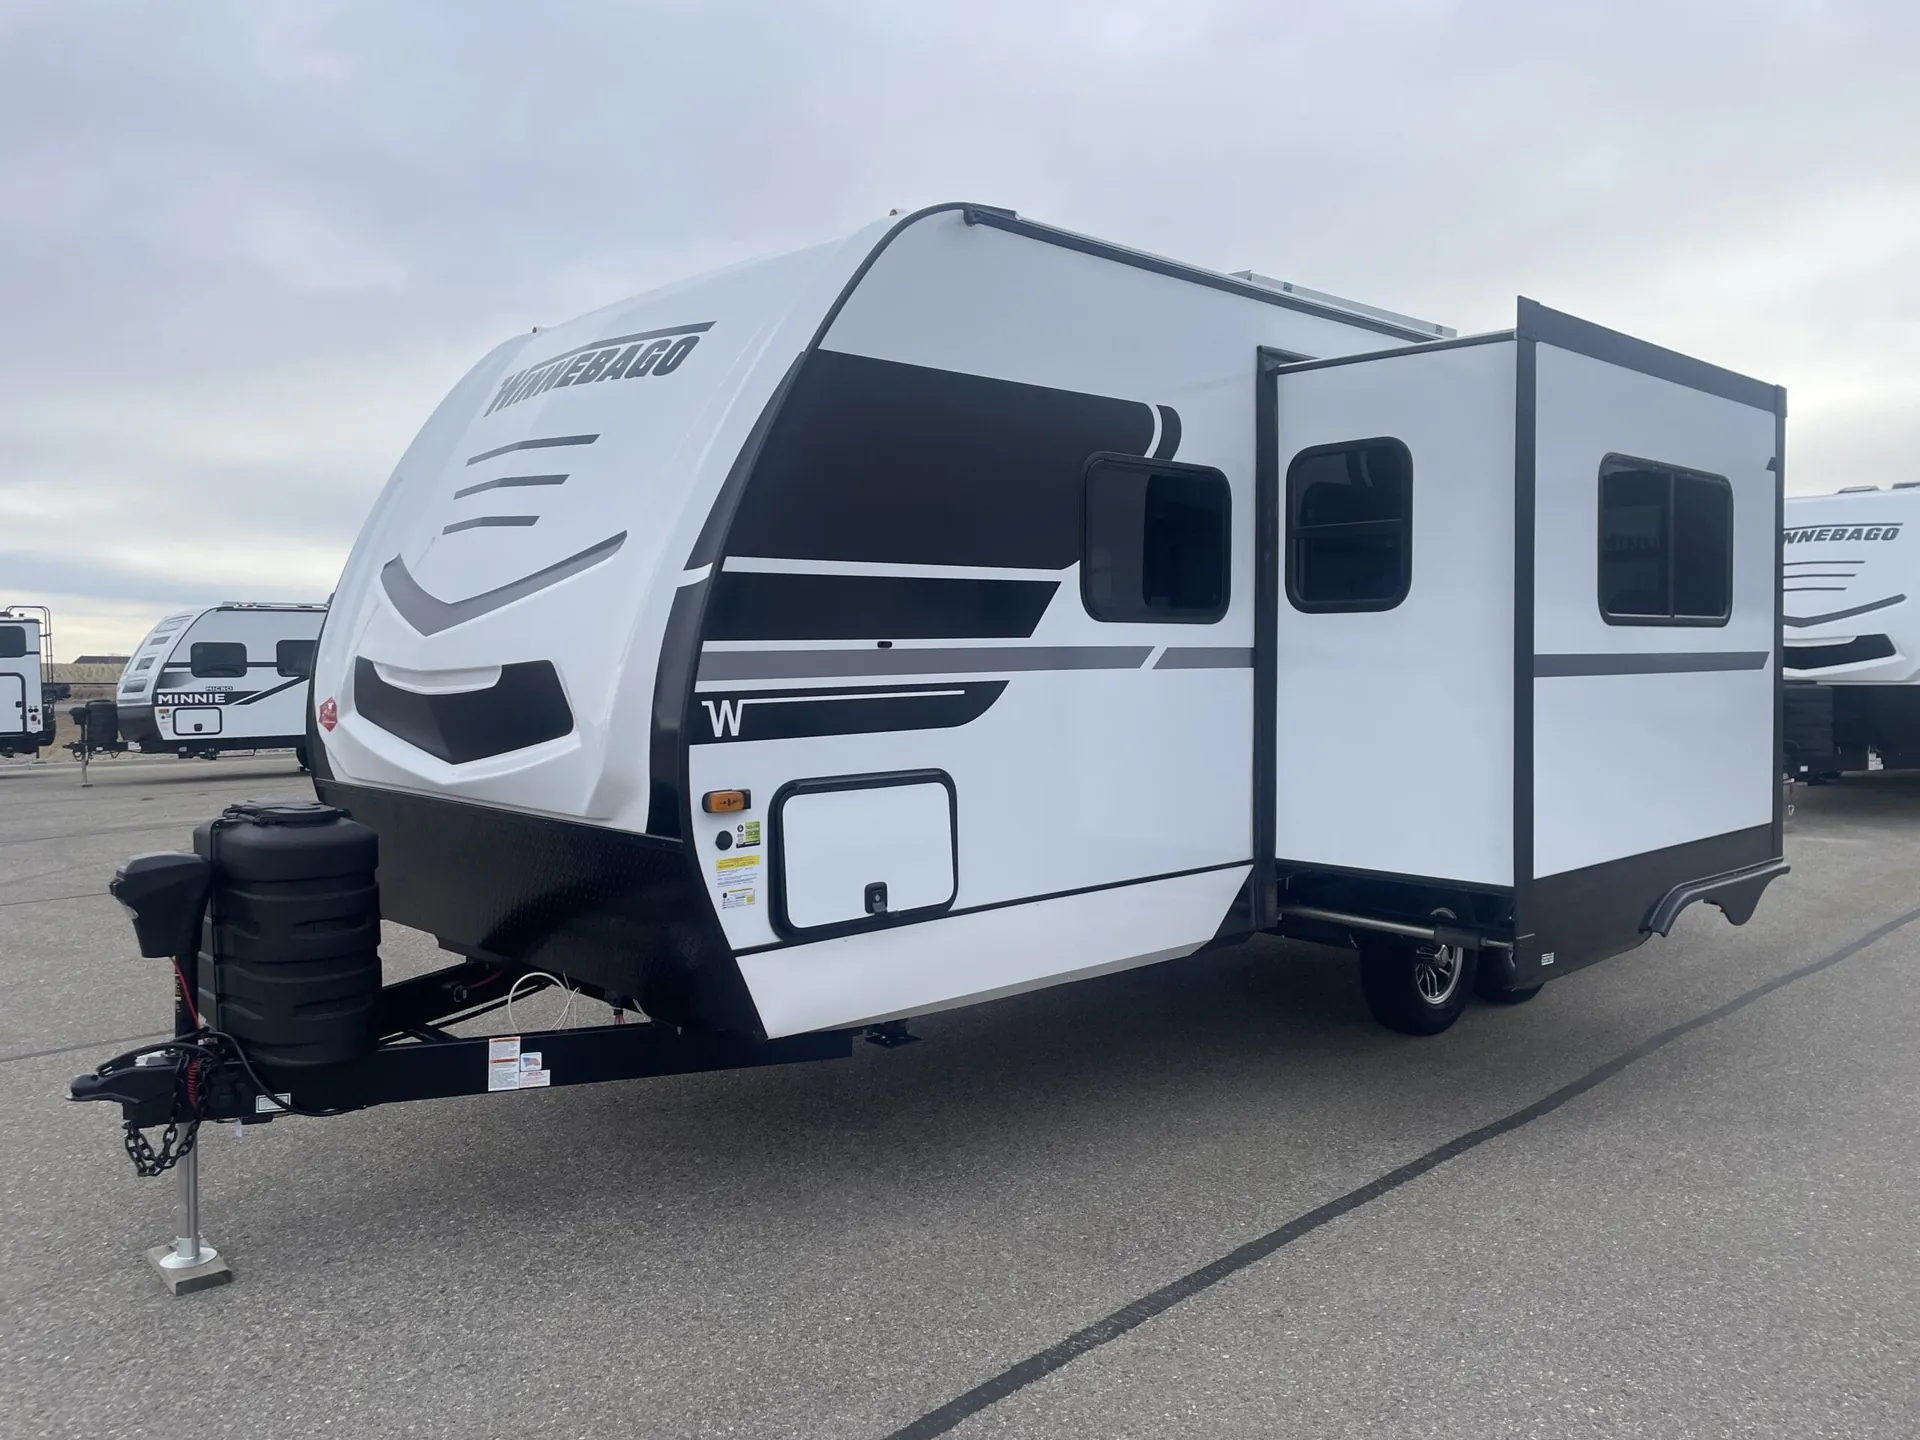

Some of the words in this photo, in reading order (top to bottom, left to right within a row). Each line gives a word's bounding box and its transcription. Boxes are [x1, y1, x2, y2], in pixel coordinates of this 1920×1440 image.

[483, 335, 701, 418] WINNEBAGO
[157, 693, 226, 704] MINNIE
[701, 699, 744, 738] W
